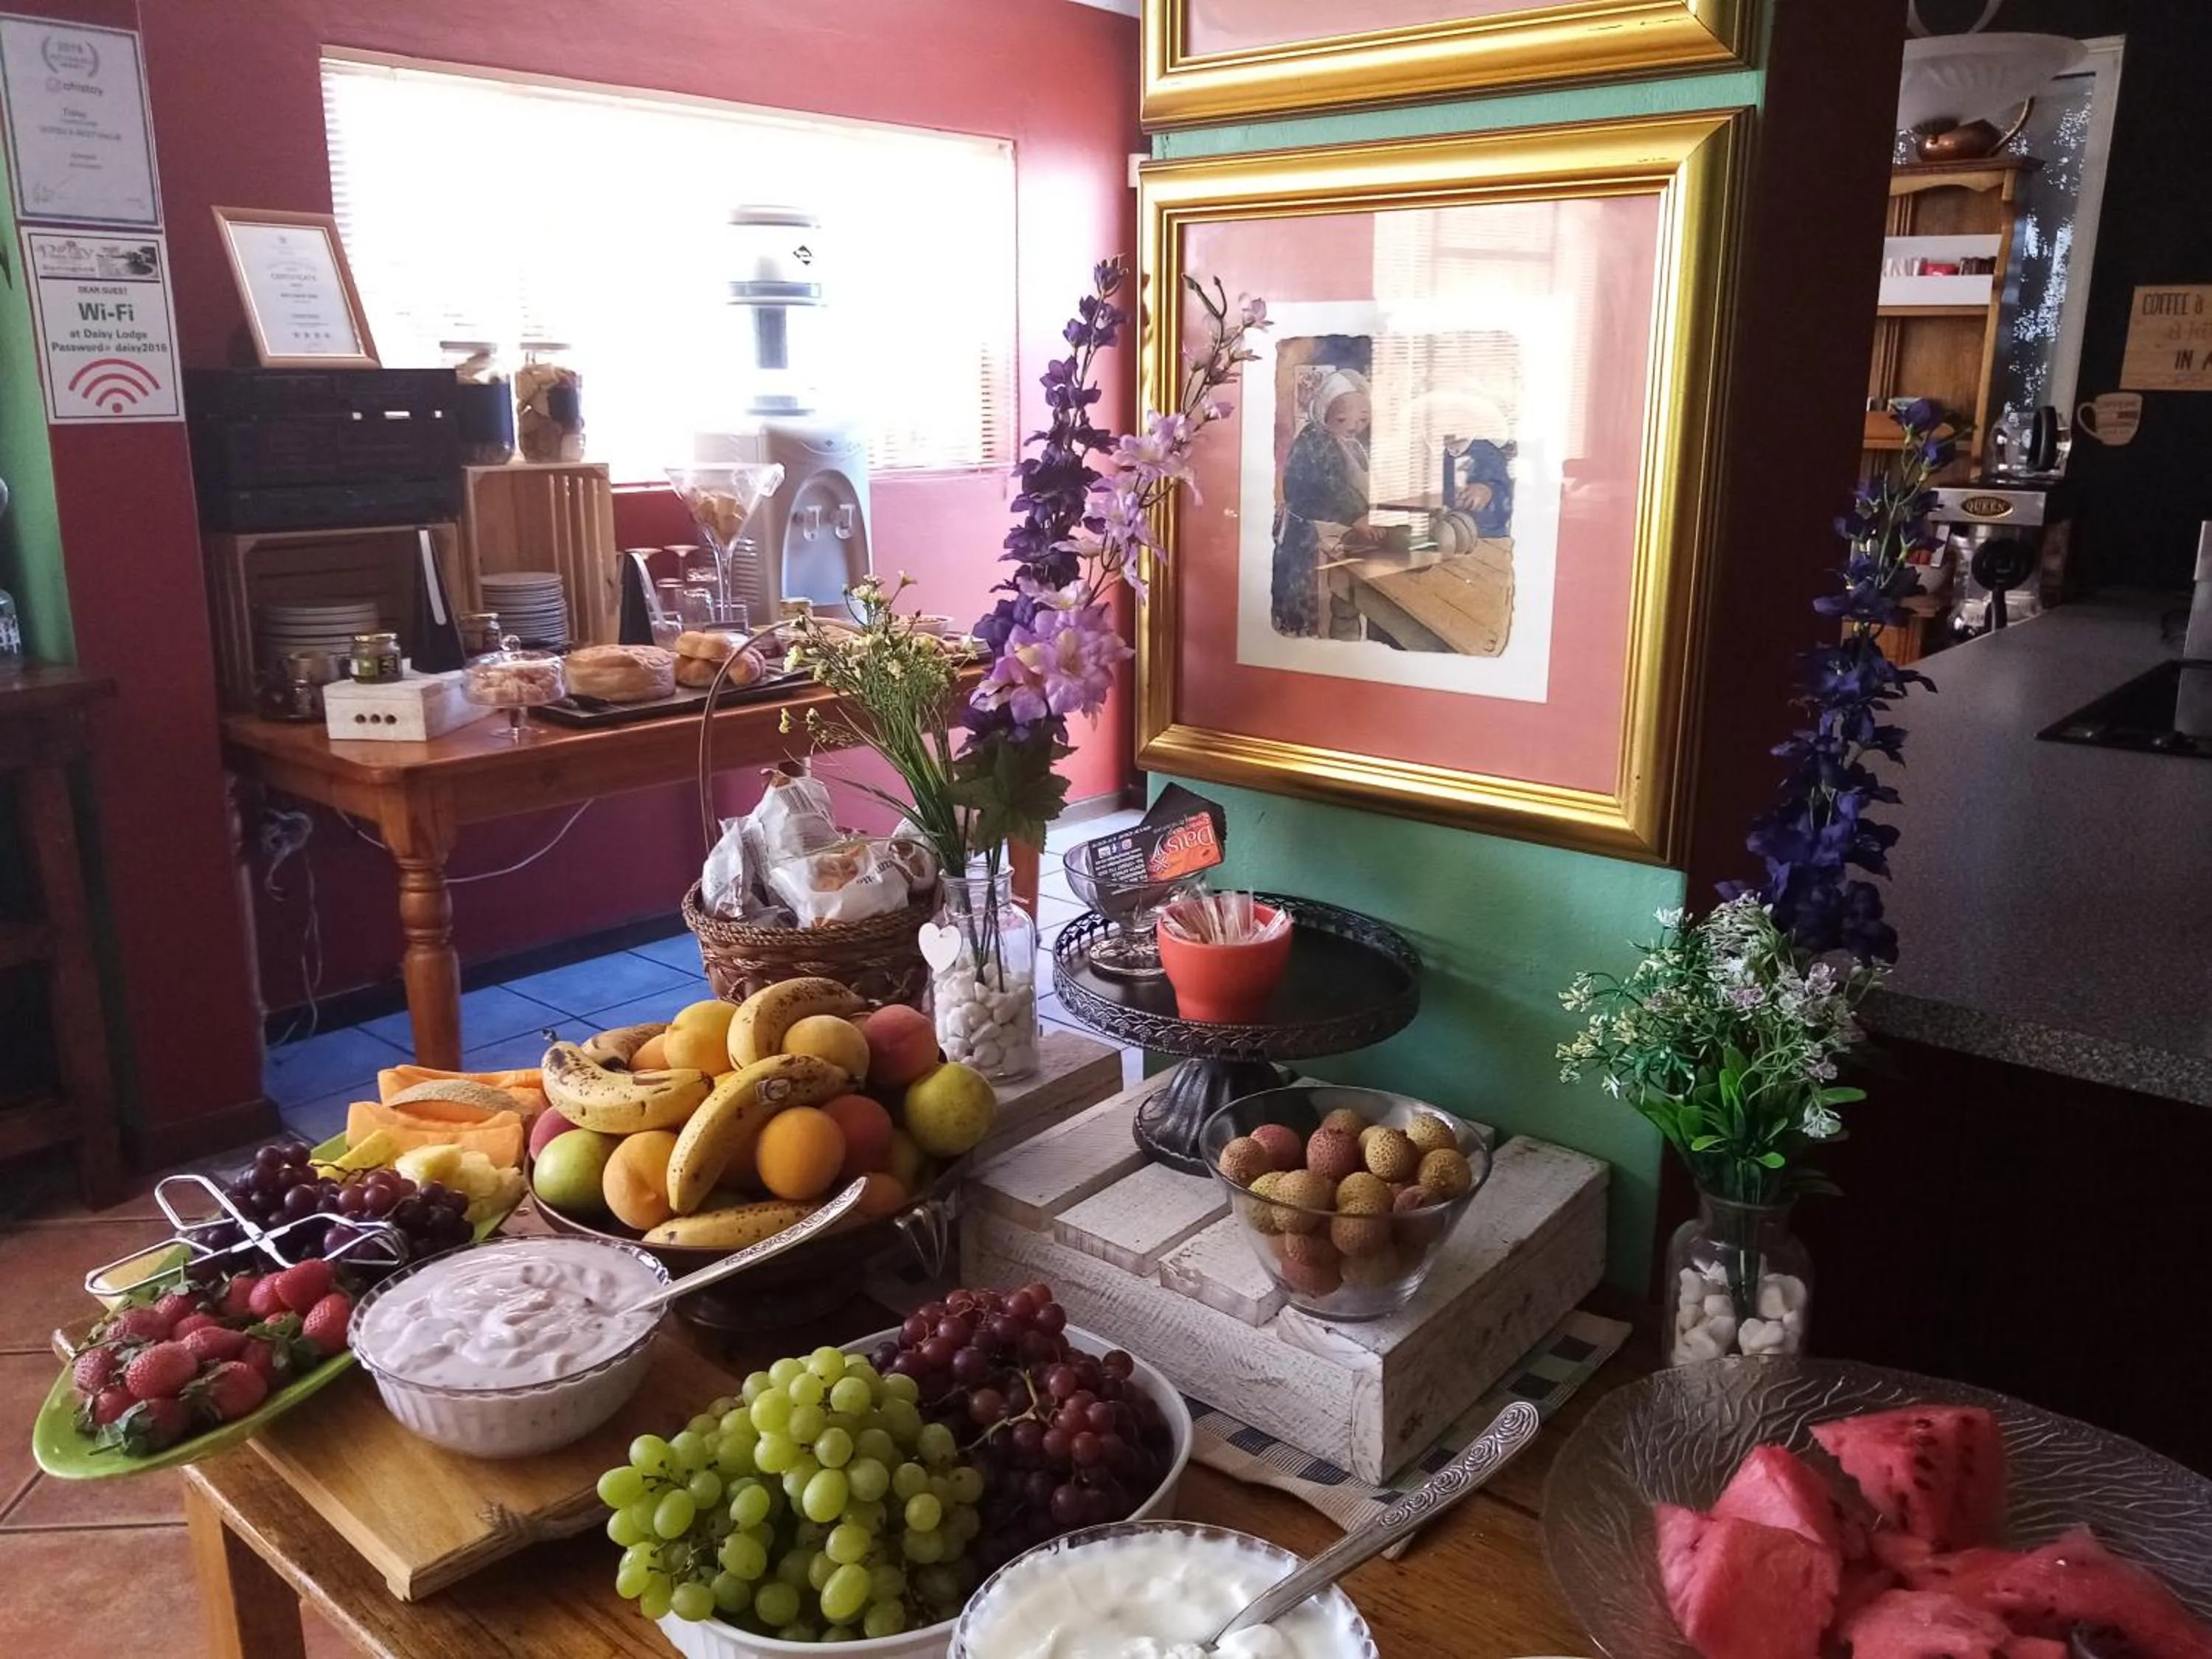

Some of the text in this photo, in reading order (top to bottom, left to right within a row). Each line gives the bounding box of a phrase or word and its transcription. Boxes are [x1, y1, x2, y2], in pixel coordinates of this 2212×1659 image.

[78, 302, 134, 321] Wi-Fi
[2143, 292, 2190, 316] COFFEE
[70, 329, 147, 341] at Daisy Lodge
[2174, 349, 2194, 370] IN
[1966, 499, 2005, 513] QUEEN
